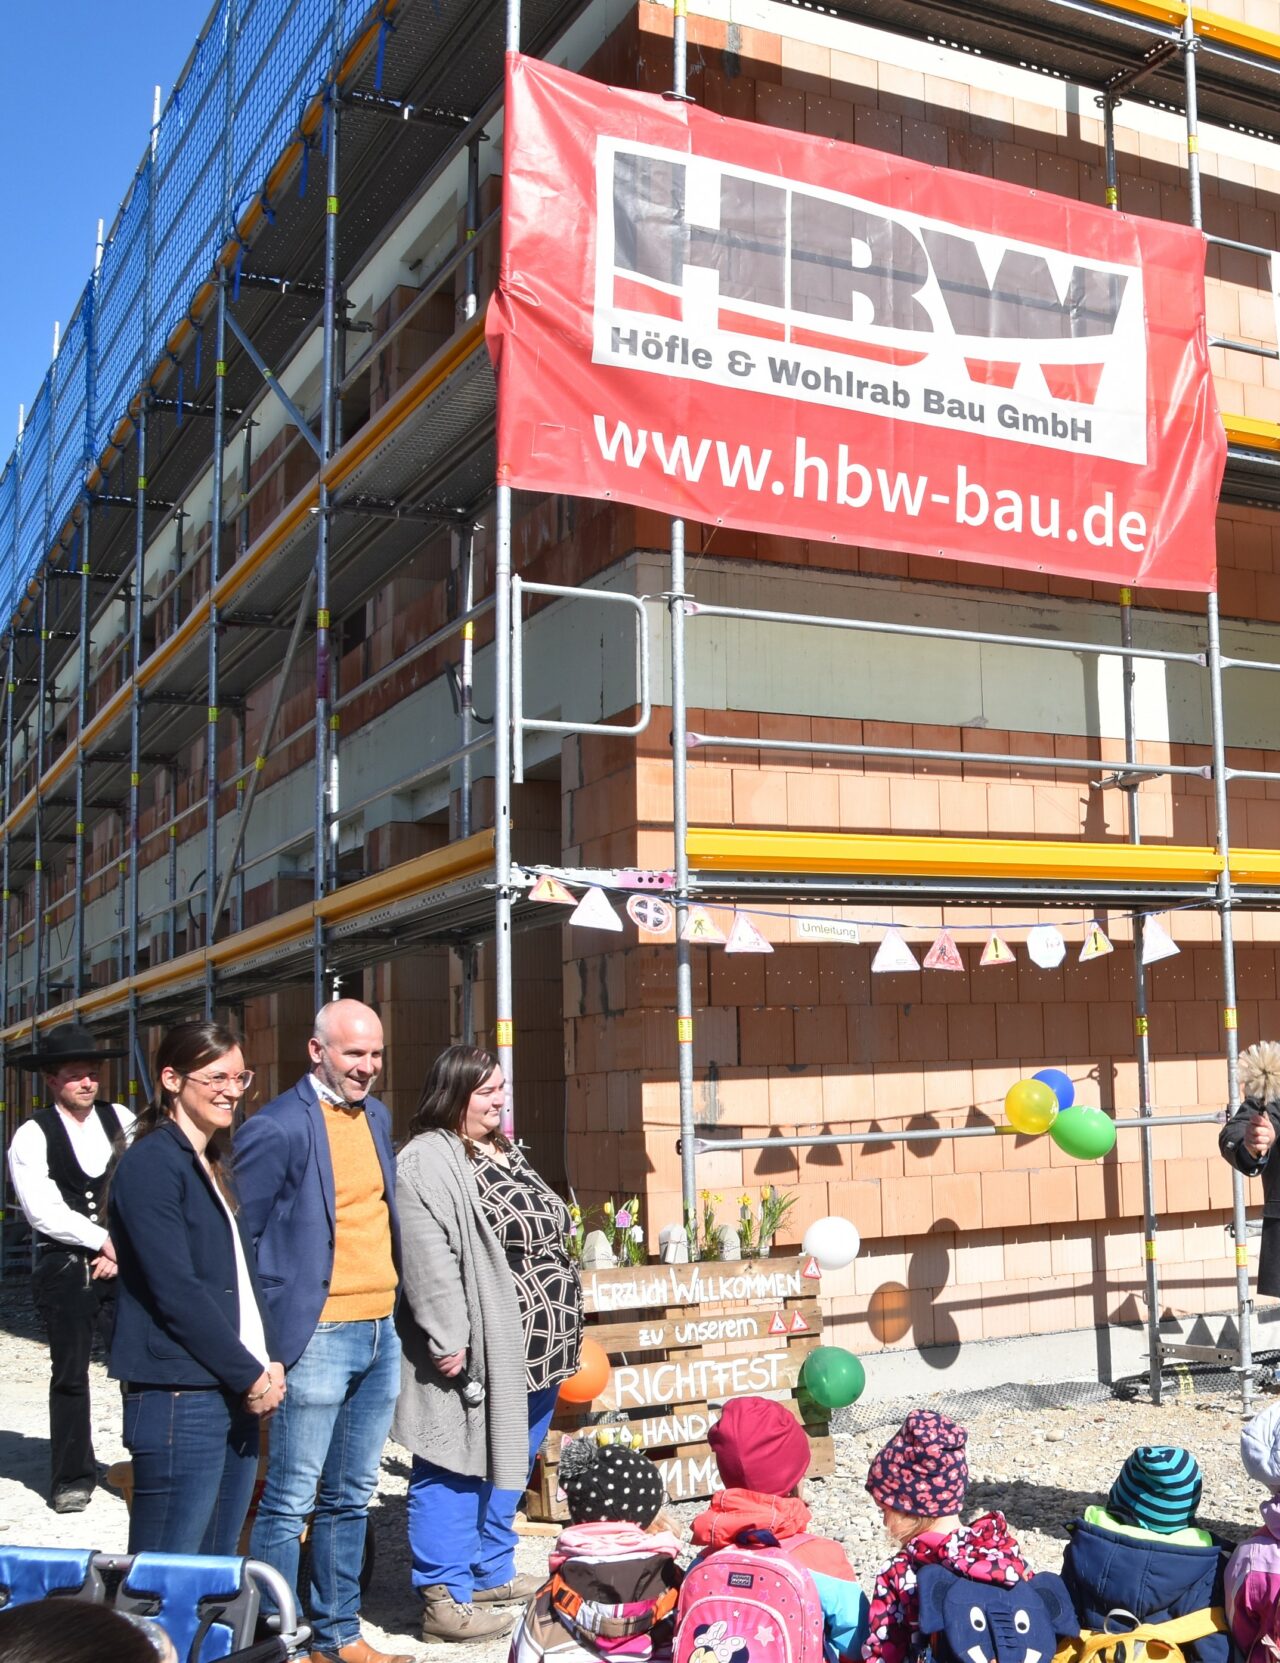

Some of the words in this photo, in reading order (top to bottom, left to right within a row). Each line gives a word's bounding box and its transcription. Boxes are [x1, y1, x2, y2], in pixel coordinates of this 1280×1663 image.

[613, 150, 1128, 405] HBW
[609, 326, 713, 372] Höfle
[726, 352, 757, 378] &
[768, 356, 910, 411] Wohlrab
[923, 388, 986, 426] Bau
[996, 402, 1093, 444] GmbH
[593, 414, 1147, 553] www.hbw-bau.de
[802, 922, 857, 940] Umleitung
[675, 1317, 758, 1344] unserem
[614, 1353, 788, 1407] RICHTFEST
